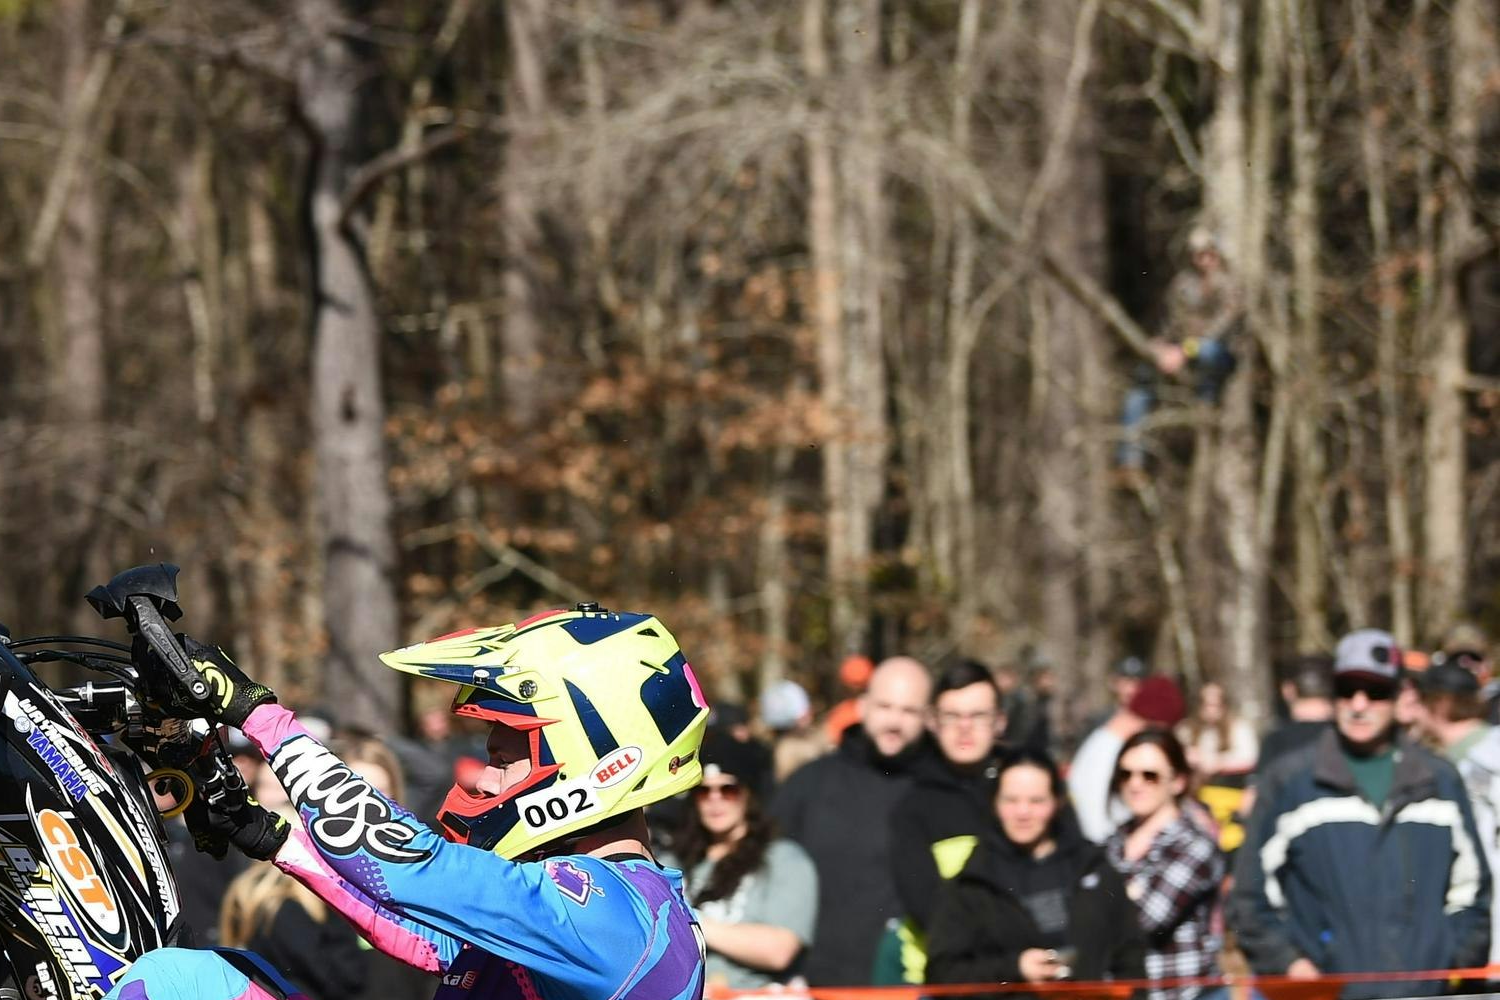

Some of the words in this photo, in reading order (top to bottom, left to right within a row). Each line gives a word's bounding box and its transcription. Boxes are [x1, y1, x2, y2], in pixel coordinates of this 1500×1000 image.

[18, 699, 105, 795] WAYNESBURG
[26, 727, 89, 803] YAMAHA
[596, 753, 636, 783] BELL
[524, 788, 594, 828] 002
[39, 810, 115, 911] CST
